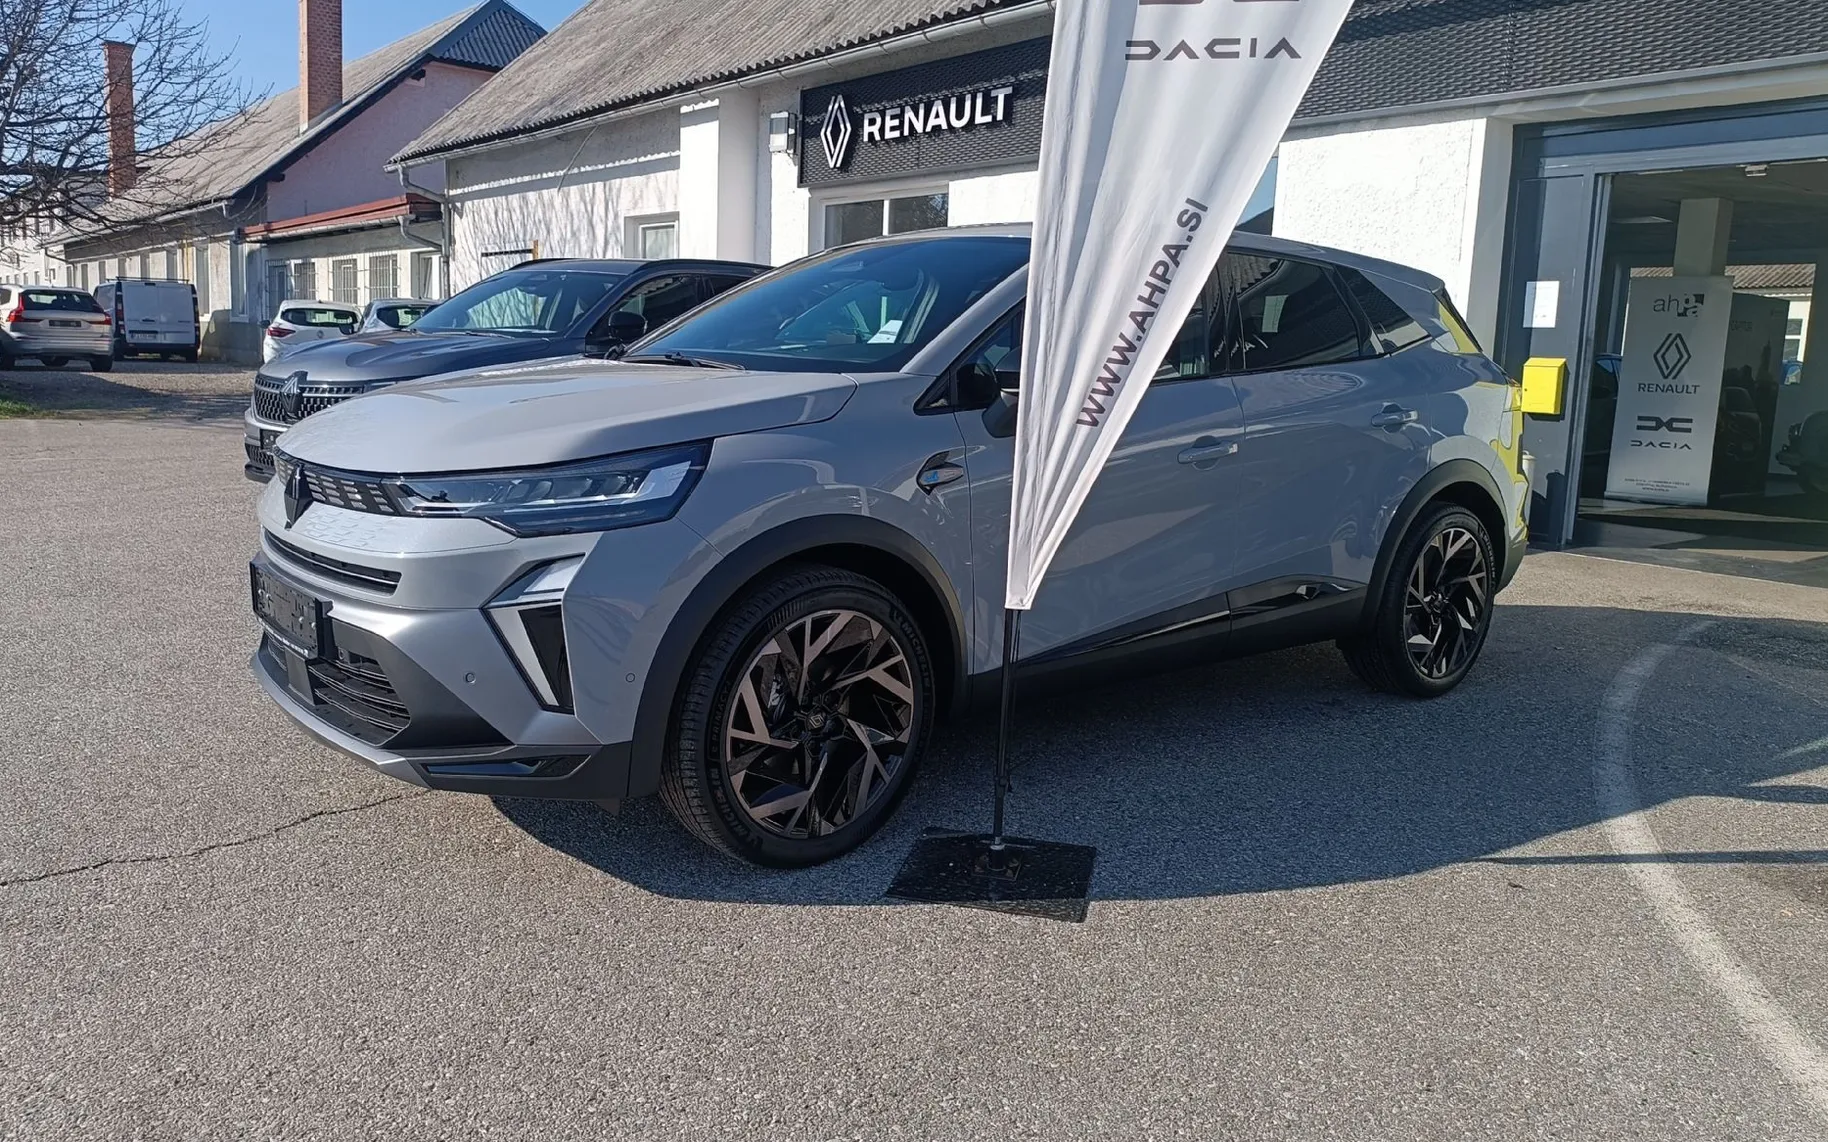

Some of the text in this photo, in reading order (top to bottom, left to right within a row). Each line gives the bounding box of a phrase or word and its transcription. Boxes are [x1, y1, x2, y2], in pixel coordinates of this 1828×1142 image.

[1125, 36, 1302, 61] DACIA
[863, 86, 1013, 142] RENAULT
[1076, 197, 1209, 428] WWW.AHPA.SI
[1637, 382, 1700, 395] RENAULT
[1630, 439, 1692, 450] DACIA
